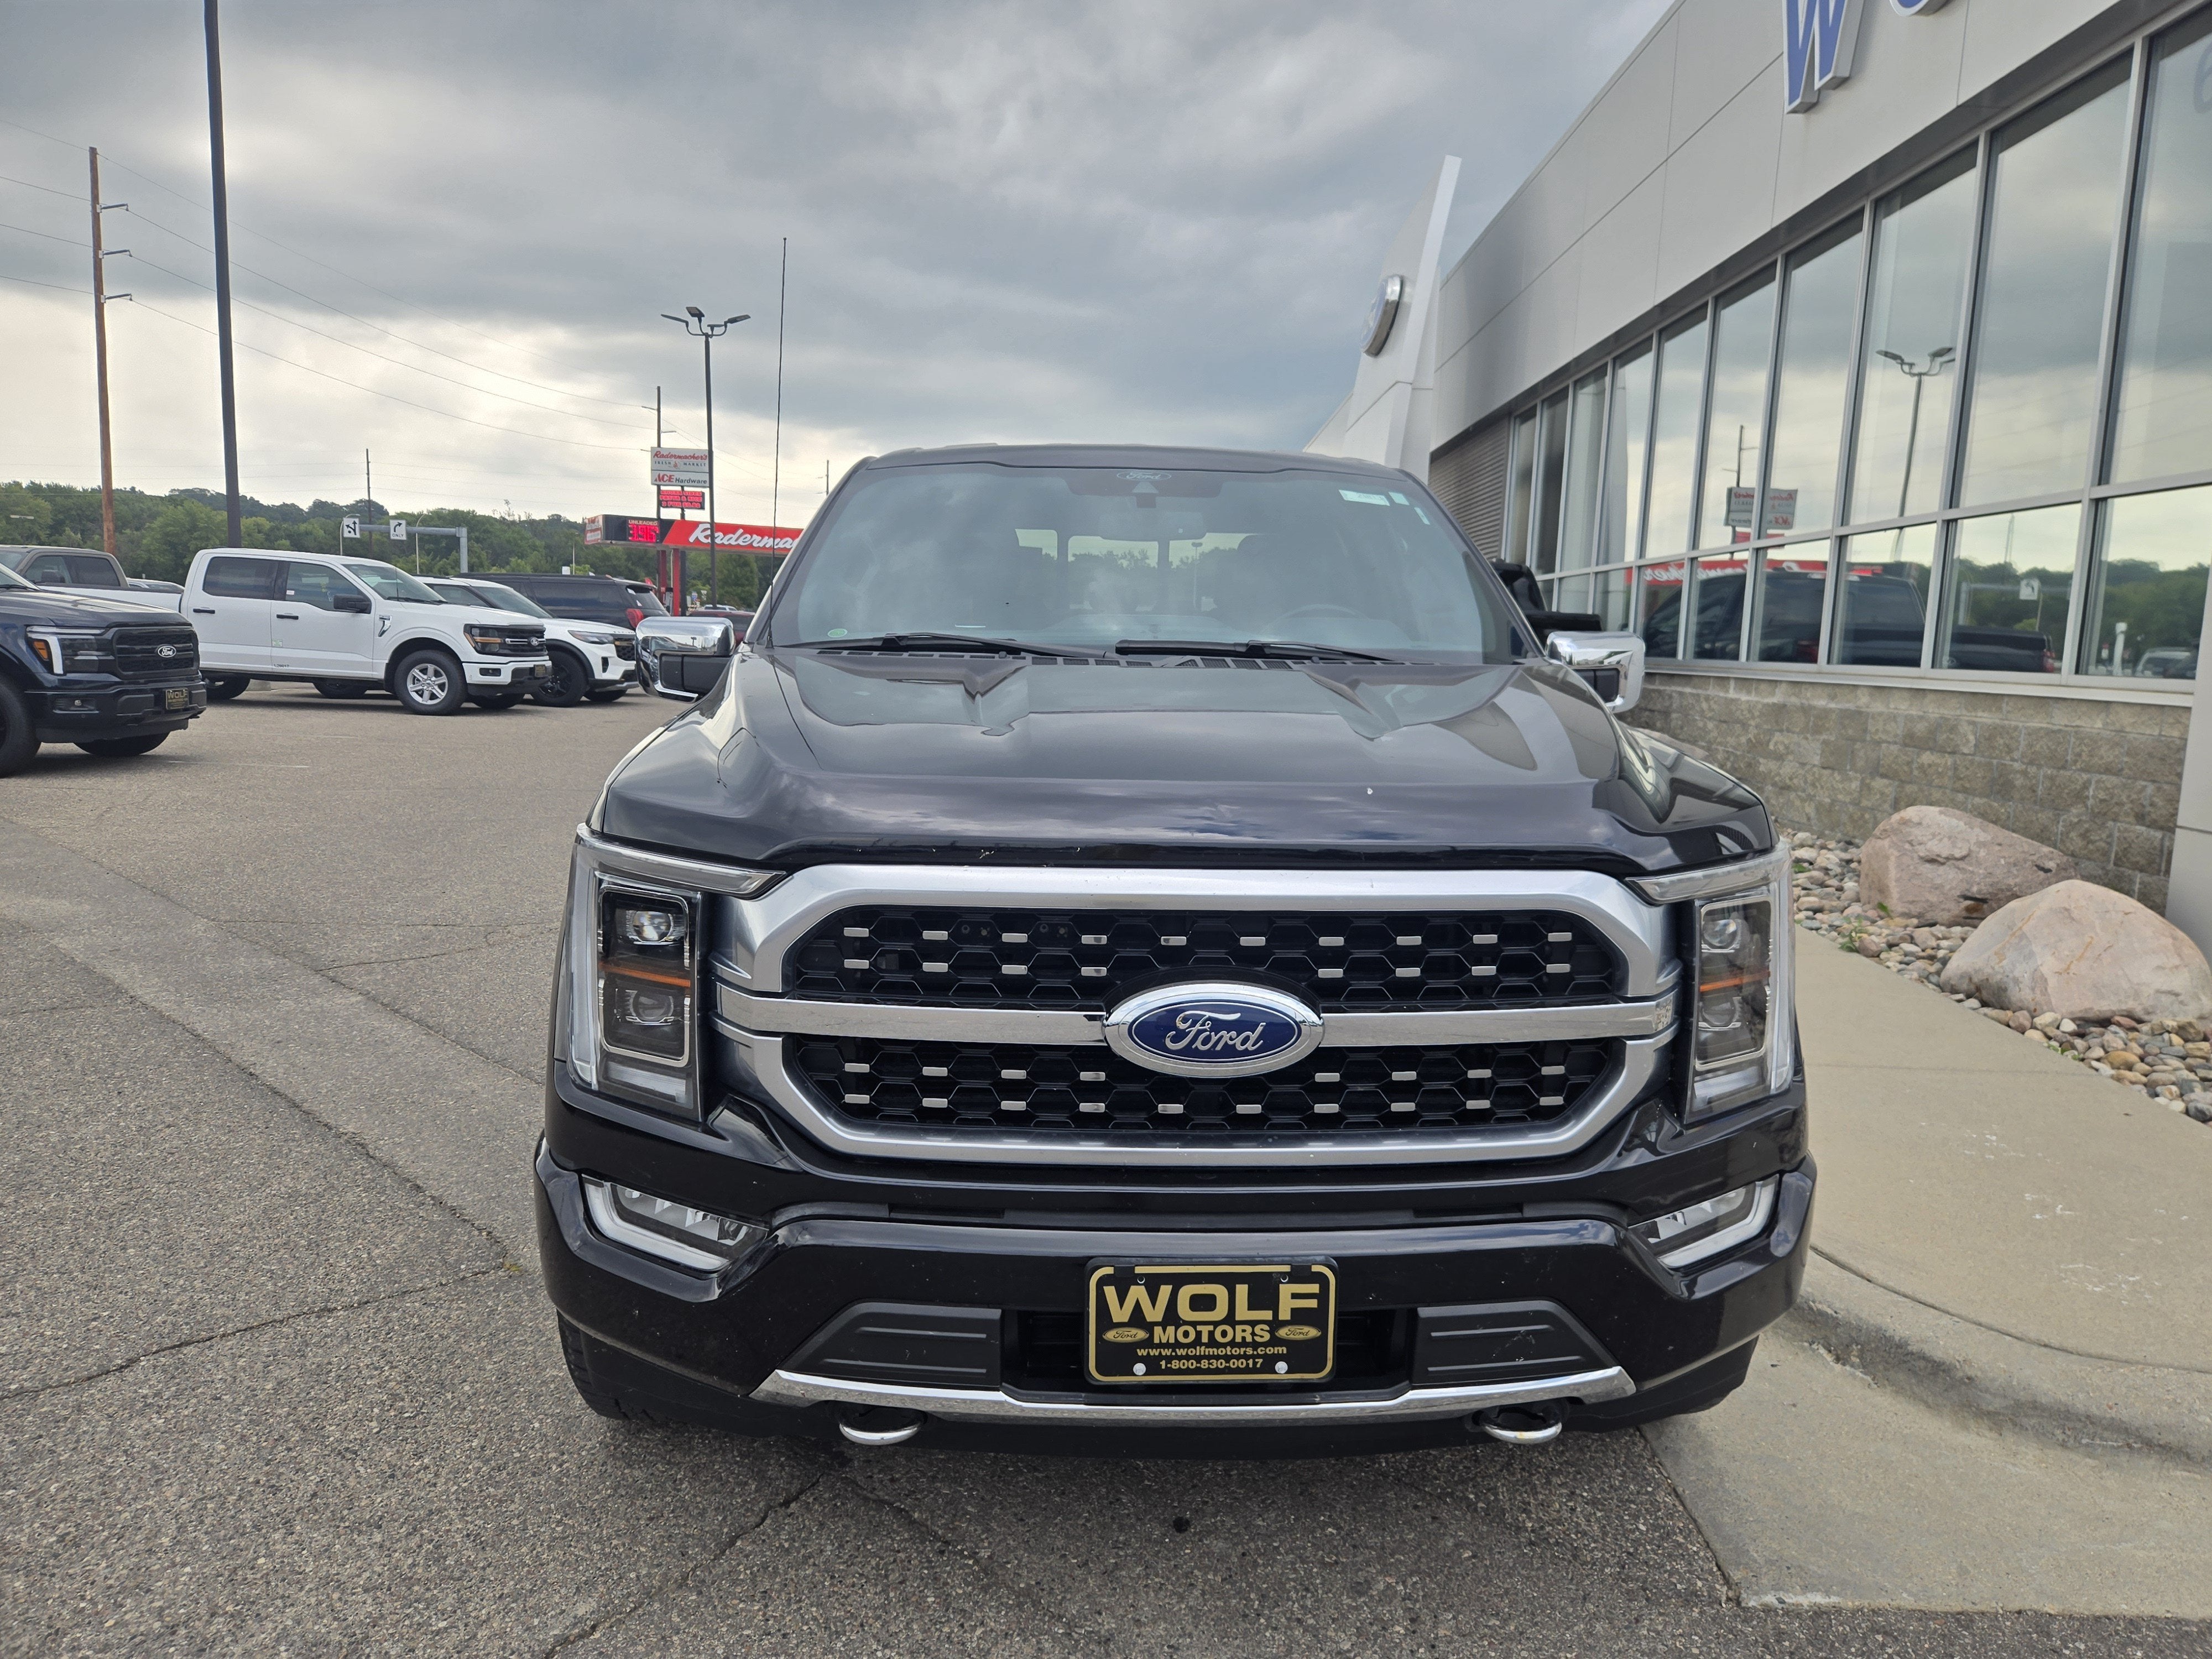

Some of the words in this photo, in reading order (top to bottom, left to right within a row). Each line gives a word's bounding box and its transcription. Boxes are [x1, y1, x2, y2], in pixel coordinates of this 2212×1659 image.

[653, 451, 708, 460] Radermacher's
[654, 473, 675, 483] ACE
[167, 690, 188, 698] WOLF
[1166, 1010, 1266, 1051] Ford
[1103, 1284, 1320, 1323] WOLF
[1154, 1324, 1271, 1344] MOTORS
[1136, 1345, 1287, 1357] www.wolfmotors.com
[1159, 1358, 1264, 1369] 1-800-830-0017
